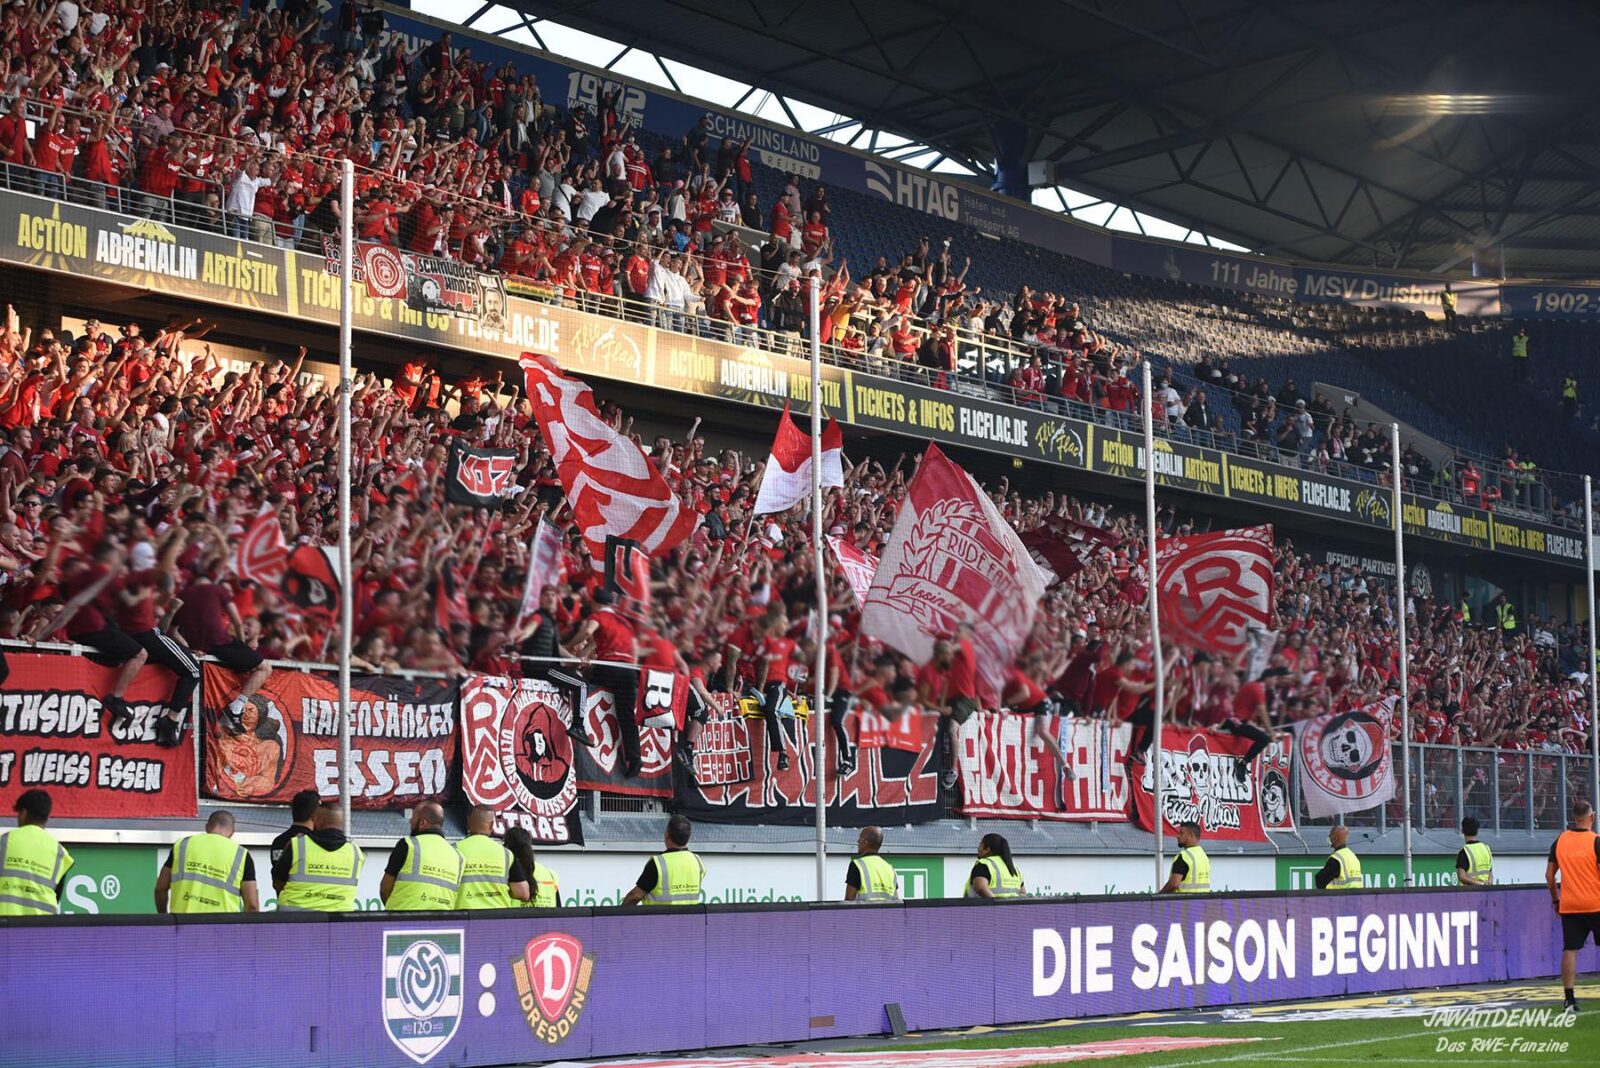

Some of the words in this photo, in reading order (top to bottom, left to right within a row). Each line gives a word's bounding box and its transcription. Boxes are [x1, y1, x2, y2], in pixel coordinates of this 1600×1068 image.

[704, 112, 820, 163] SCHAUINSLAND
[767, 155, 815, 179] REISEN
[897, 169, 959, 222] HTAG
[964, 212, 1003, 236] Transport
[1006, 225, 1020, 239] AG
[17, 207, 88, 259] ACTION
[96, 230, 199, 281] ADRENALIN
[202, 246, 279, 296] ARTISTIK
[302, 268, 375, 317] TICKTS
[1211, 260, 1240, 284] 111
[1246, 267, 1299, 295] Jahre
[1304, 275, 1357, 299] MSV
[670, 350, 716, 383] ACTION
[720, 358, 788, 397] ADRENALIN
[790, 376, 842, 409] ARTSTIK
[856, 384, 905, 423] TICKETS
[908, 400, 918, 425] &
[920, 399, 955, 433] INFOS
[960, 411, 1028, 447] FLICFLAC.DE
[1103, 435, 1134, 468] ACTION
[1137, 446, 1184, 477] AENALIN
[1185, 454, 1220, 485] ARTISTIK
[1229, 464, 1265, 496] TICKETS
[1266, 474, 1273, 497] &
[1274, 474, 1299, 502] INFOS
[1302, 480, 1351, 513] FLICFLAC.DE
[1402, 502, 1426, 527] ACTION
[1427, 509, 1461, 534] ADRENALIN
[1461, 516, 1488, 540] ARTISTIK
[1494, 521, 1520, 548] TICKETS
[1520, 532, 1526, 549] &
[1526, 531, 1545, 552] INFOS
[1546, 533, 1584, 561] FLICFLAC.DE
[1326, 551, 1359, 569] OFFICIAL
[1361, 558, 1396, 576] PARTNER
[0, 692, 103, 735] THSIDE
[111, 704, 188, 742] CRE
[23, 752, 91, 785] WEISS
[97, 756, 162, 792] ESSEN
[313, 747, 448, 798] ESSEN
[958, 711, 1045, 809] RUDE
[535, 798, 567, 818] WEISS
[1032, 924, 1114, 997] DIE
[1130, 918, 1296, 989] SAISON
[1311, 910, 1479, 977] BEGINNT!
[413, 1020, 433, 1035] 120
[519, 990, 587, 1045] DRESDEN
